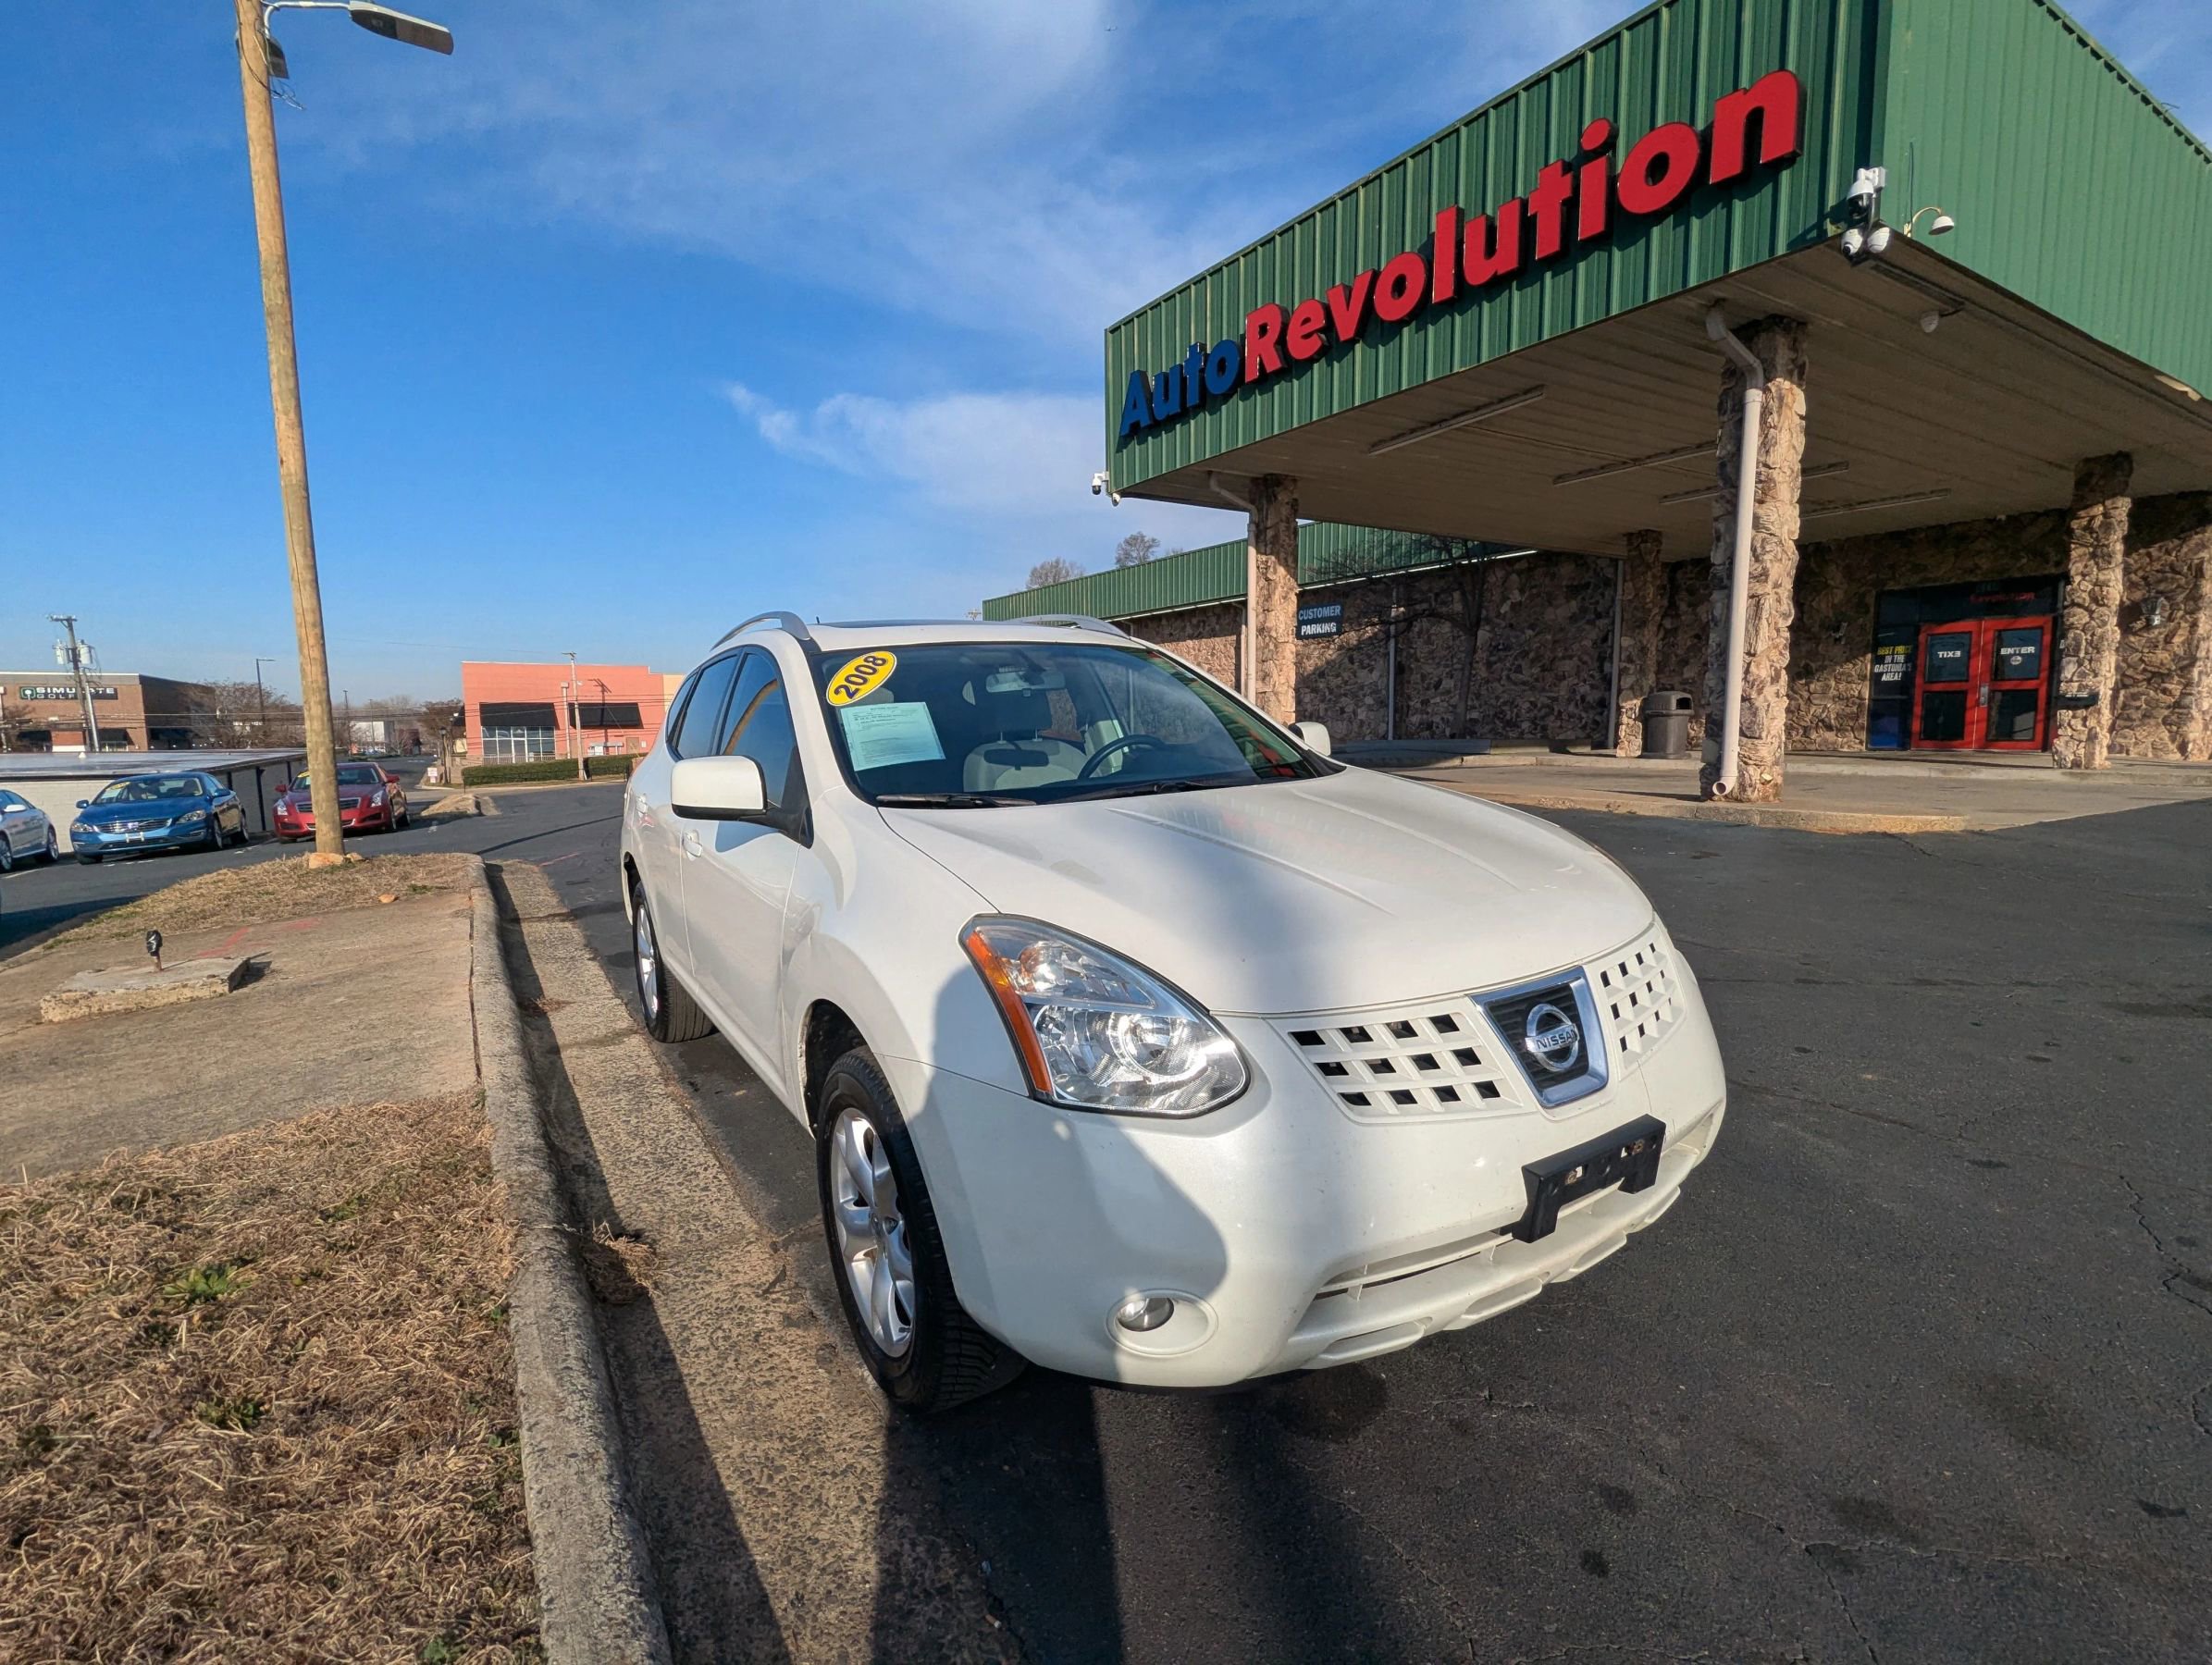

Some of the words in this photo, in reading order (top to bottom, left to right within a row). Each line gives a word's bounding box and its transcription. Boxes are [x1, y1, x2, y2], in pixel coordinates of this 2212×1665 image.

[1299, 606, 1341, 620] CUSTOMER
[1302, 623, 1337, 635] PARKING
[1877, 646, 1894, 655] BEST
[2000, 646, 2035, 655] ENTER
[1885, 655, 1892, 663] IN
[1894, 654, 1906, 663] THE
[834, 655, 887, 698] 2008
[1881, 672, 1902, 681] AREA!
